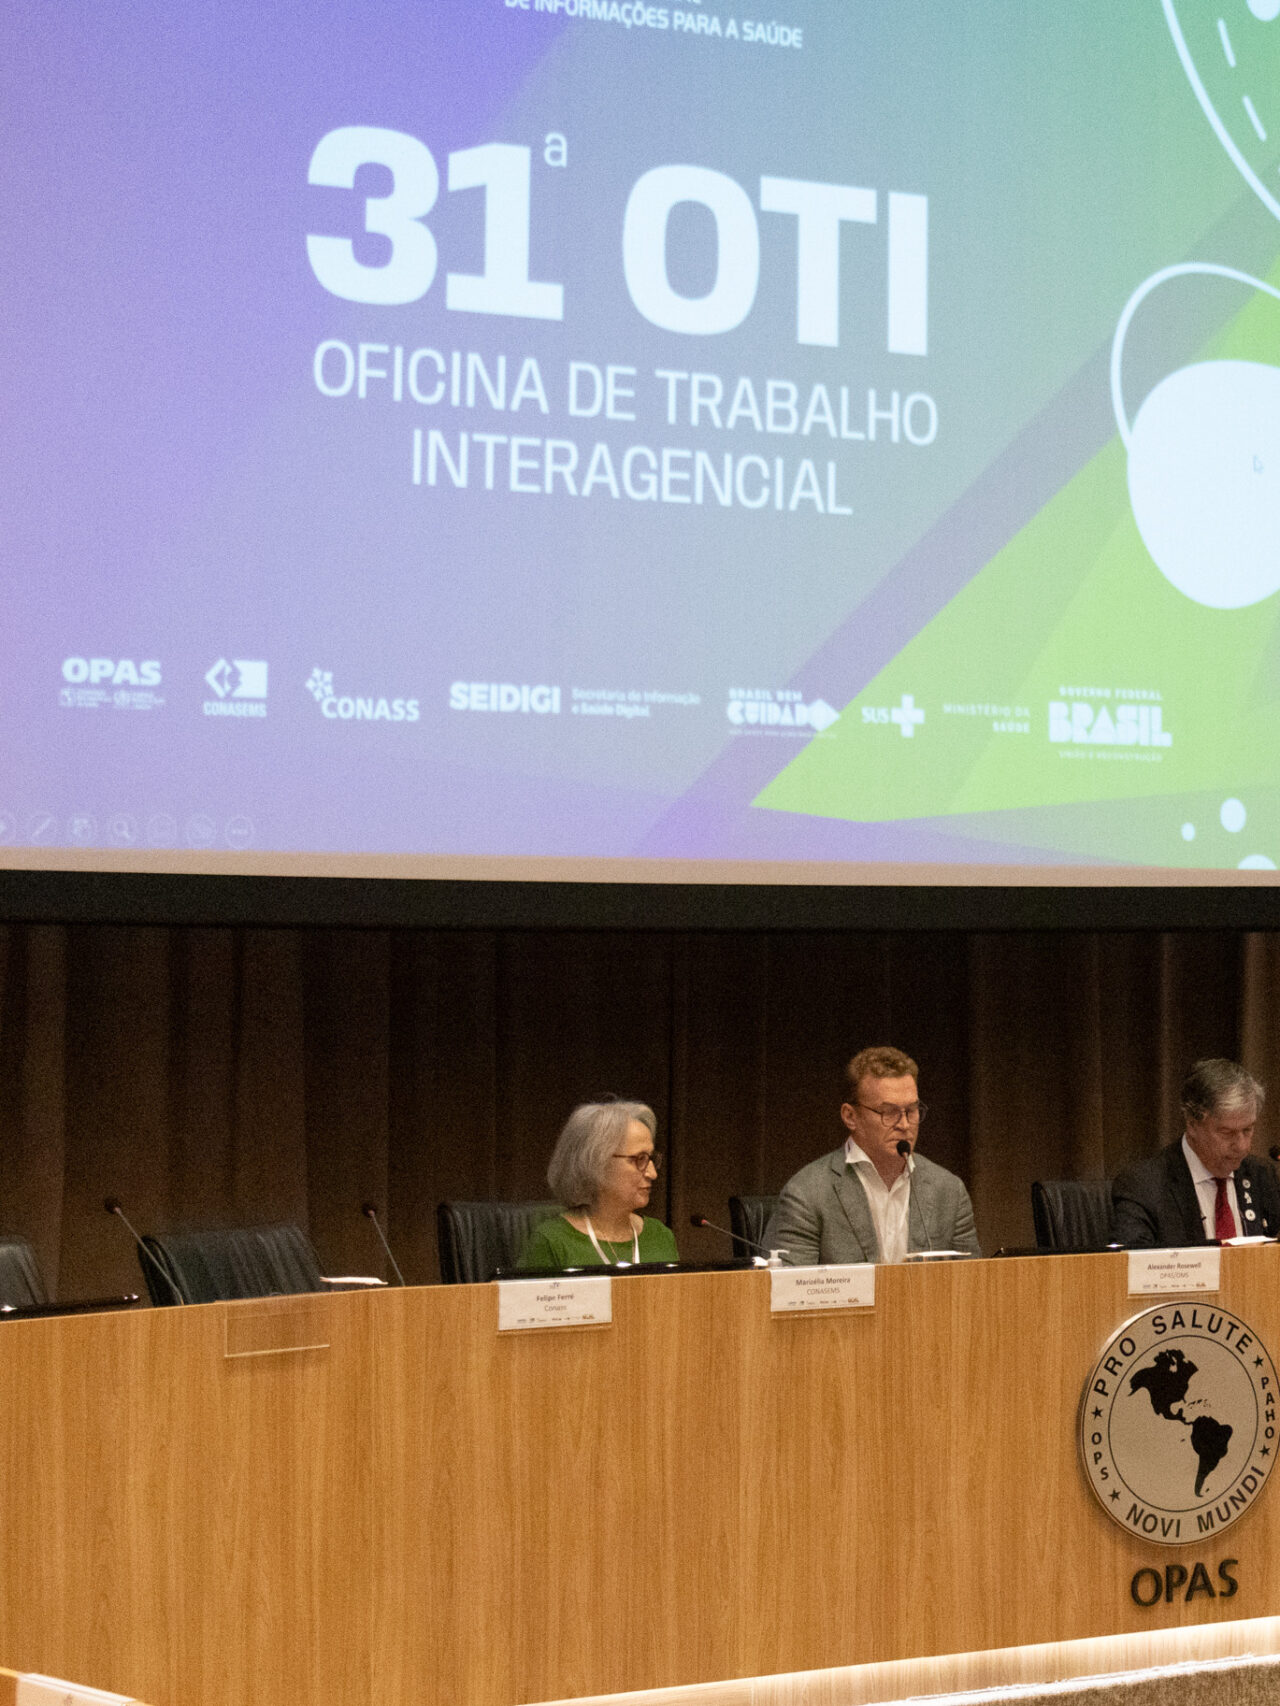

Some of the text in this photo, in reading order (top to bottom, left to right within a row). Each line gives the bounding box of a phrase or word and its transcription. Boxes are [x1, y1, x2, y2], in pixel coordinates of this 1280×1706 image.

[673, 10, 722, 37] PARA
[725, 18, 739, 39] A
[742, 20, 803, 49] SAÚDE
[622, 163, 928, 356] OTI
[313, 339, 938, 446] OFICINA DE TRABALHO
[412, 429, 853, 516] INTERAGENCIAL
[62, 656, 162, 686] OPAS
[203, 701, 267, 717] CONASEMS
[321, 697, 420, 721] CONASS
[450, 681, 561, 714] SEIDIGI
[1048, 701, 1173, 747] BRASIL
[1093, 1309, 1253, 1397] PRO SALUTE
[1261, 1376, 1275, 1439] PAHO
[1091, 1432, 1109, 1481] OPS
[1125, 1465, 1265, 1538] NOVI MUNDI
[1131, 1559, 1239, 1607] OPAS
